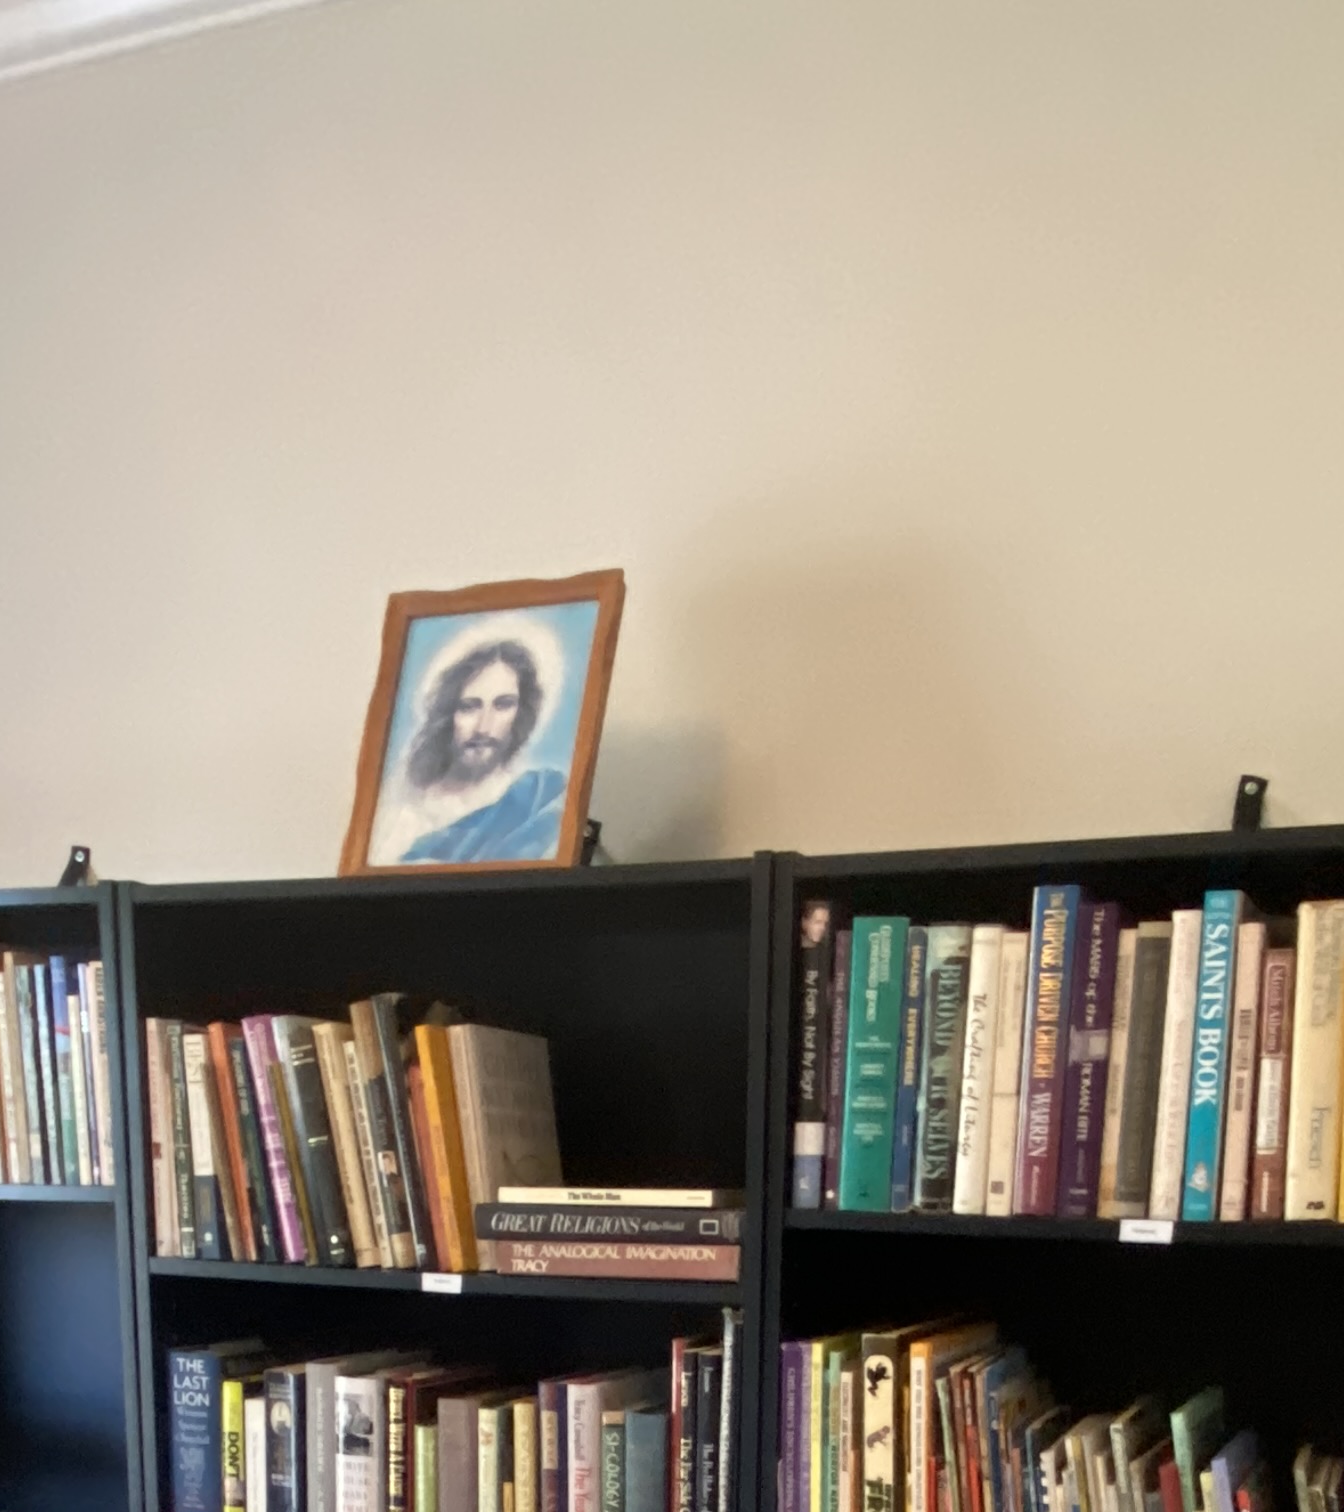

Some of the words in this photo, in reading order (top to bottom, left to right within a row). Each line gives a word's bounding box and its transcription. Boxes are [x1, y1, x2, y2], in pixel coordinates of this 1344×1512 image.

[1042, 909, 1067, 968] PURPOSE
[1200, 923, 1229, 1019] SAINTS
[934, 964, 963, 1045] BEYOND
[973, 993, 987, 1012] The
[1036, 973, 1064, 1021] DRIVEN
[1033, 1026, 1060, 1078] CHURCH
[1195, 1028, 1223, 1106] BOOK
[968, 1087, 979, 1101] of
[1077, 1063, 1092, 1111] ROMAN
[1028, 1093, 1051, 1157] WARREN
[925, 1109, 950, 1180] SELVES
[491, 1211, 547, 1231] GREAT
[550, 1211, 641, 1234] RELIGIONS
[511, 1245, 535, 1257] THE
[538, 1245, 619, 1260] ANALOGICAL
[625, 1245, 717, 1260] IMAGINATION
[511, 1259, 548, 1273] TRACY
[176, 1358, 206, 1373] THE
[174, 1374, 209, 1388] LAST
[174, 1390, 210, 1407] LION
[574, 1400, 586, 1420] Tracy
[576, 1468, 591, 1489] The
